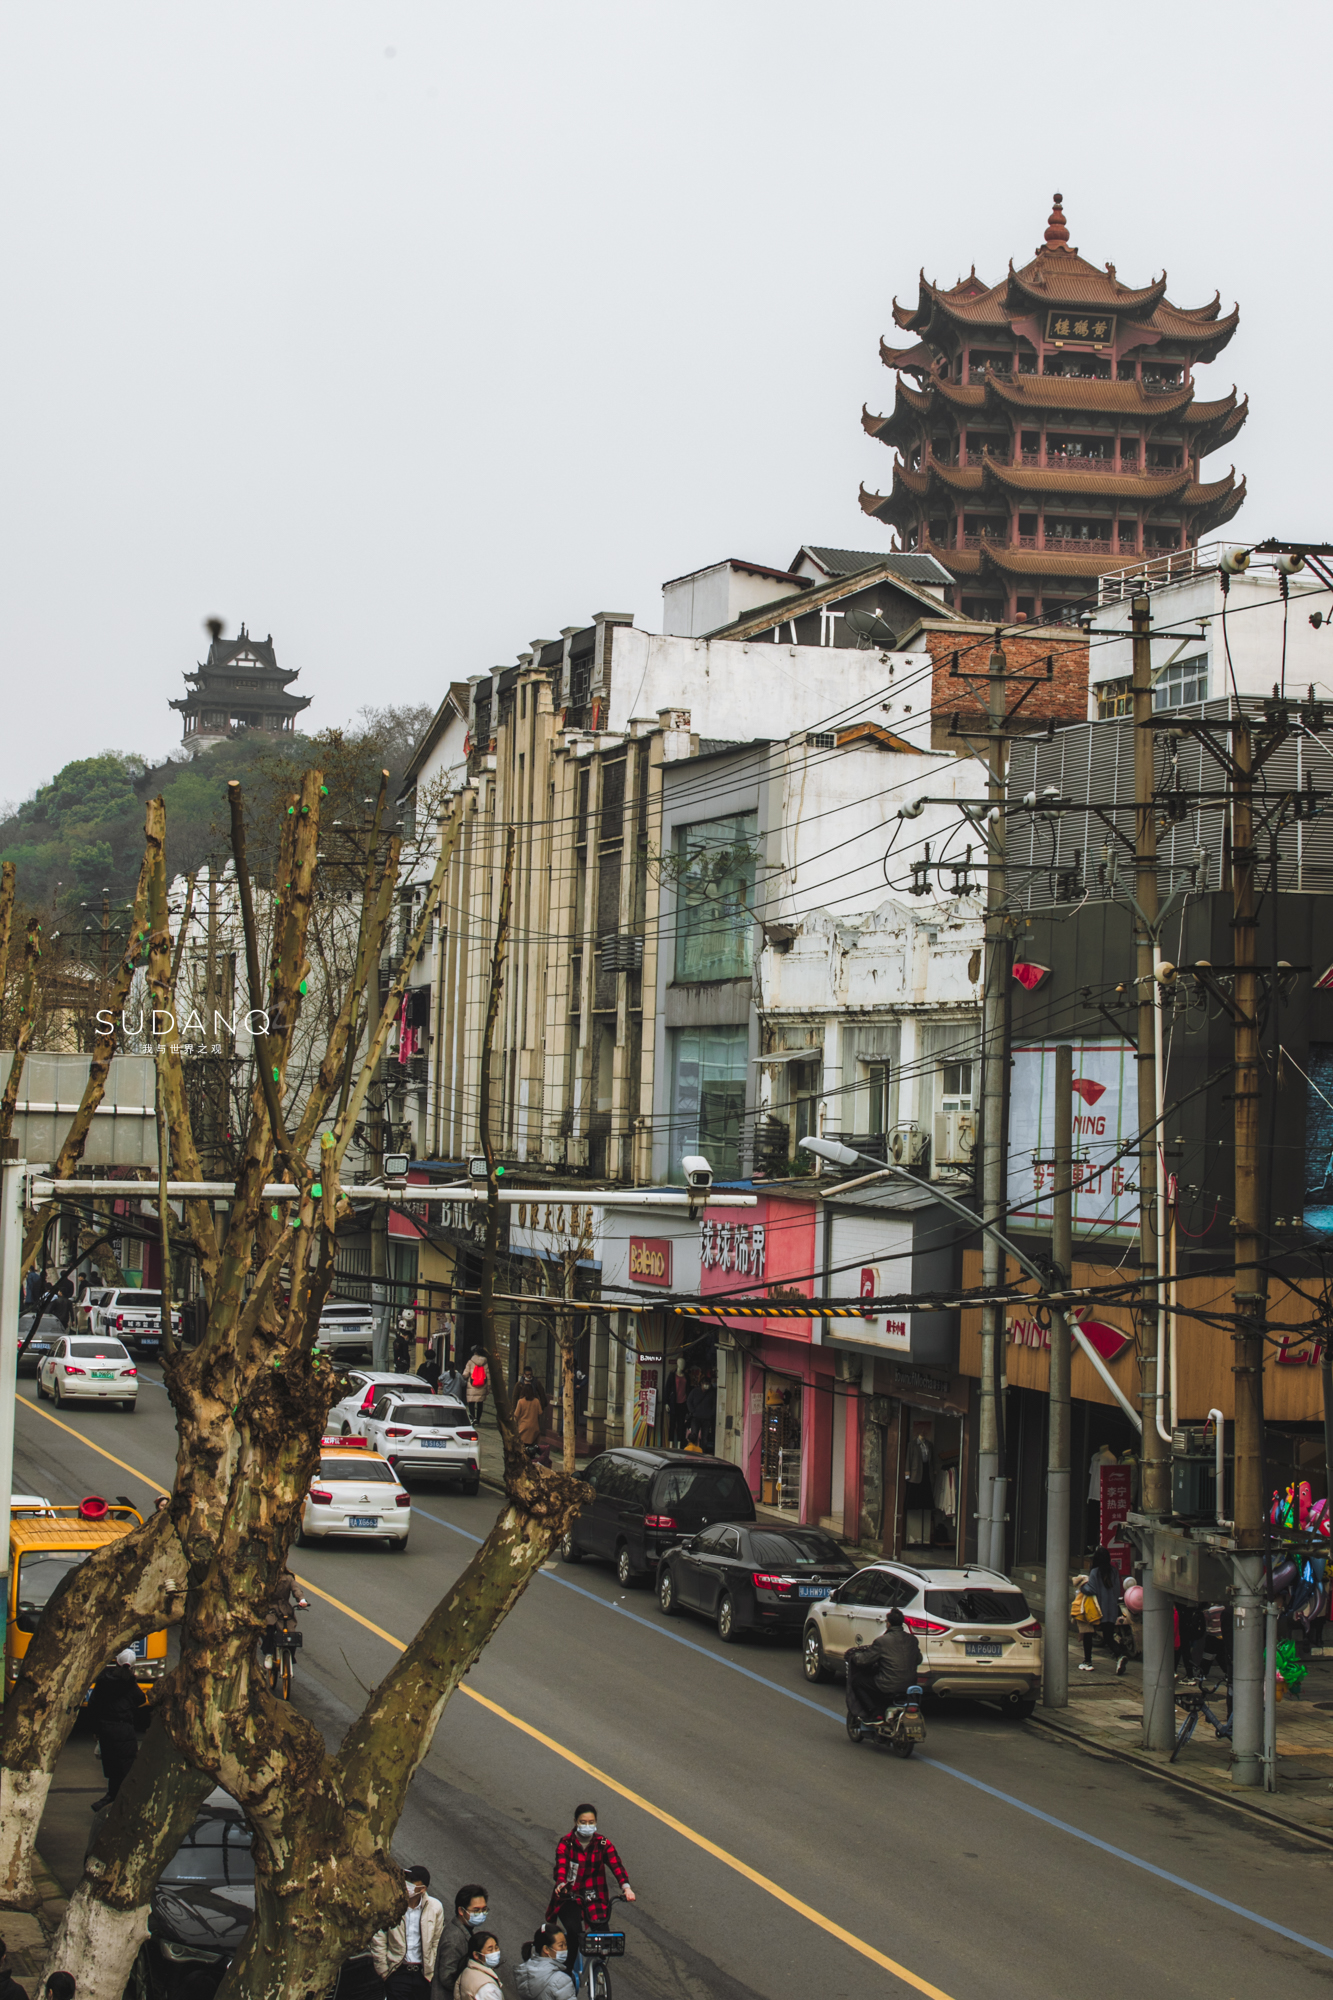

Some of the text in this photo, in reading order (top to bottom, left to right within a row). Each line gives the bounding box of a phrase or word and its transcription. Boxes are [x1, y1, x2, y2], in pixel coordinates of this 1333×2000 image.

[698, 1218, 765, 1277] 球球饰界
[631, 1242, 665, 1277] Baleno
[640, 1369, 658, 1381] BIG
[640, 1380, 658, 1390] SALE
[1106, 1486, 1127, 1497] 李宁
[1106, 1498, 1127, 1510] 热卖
